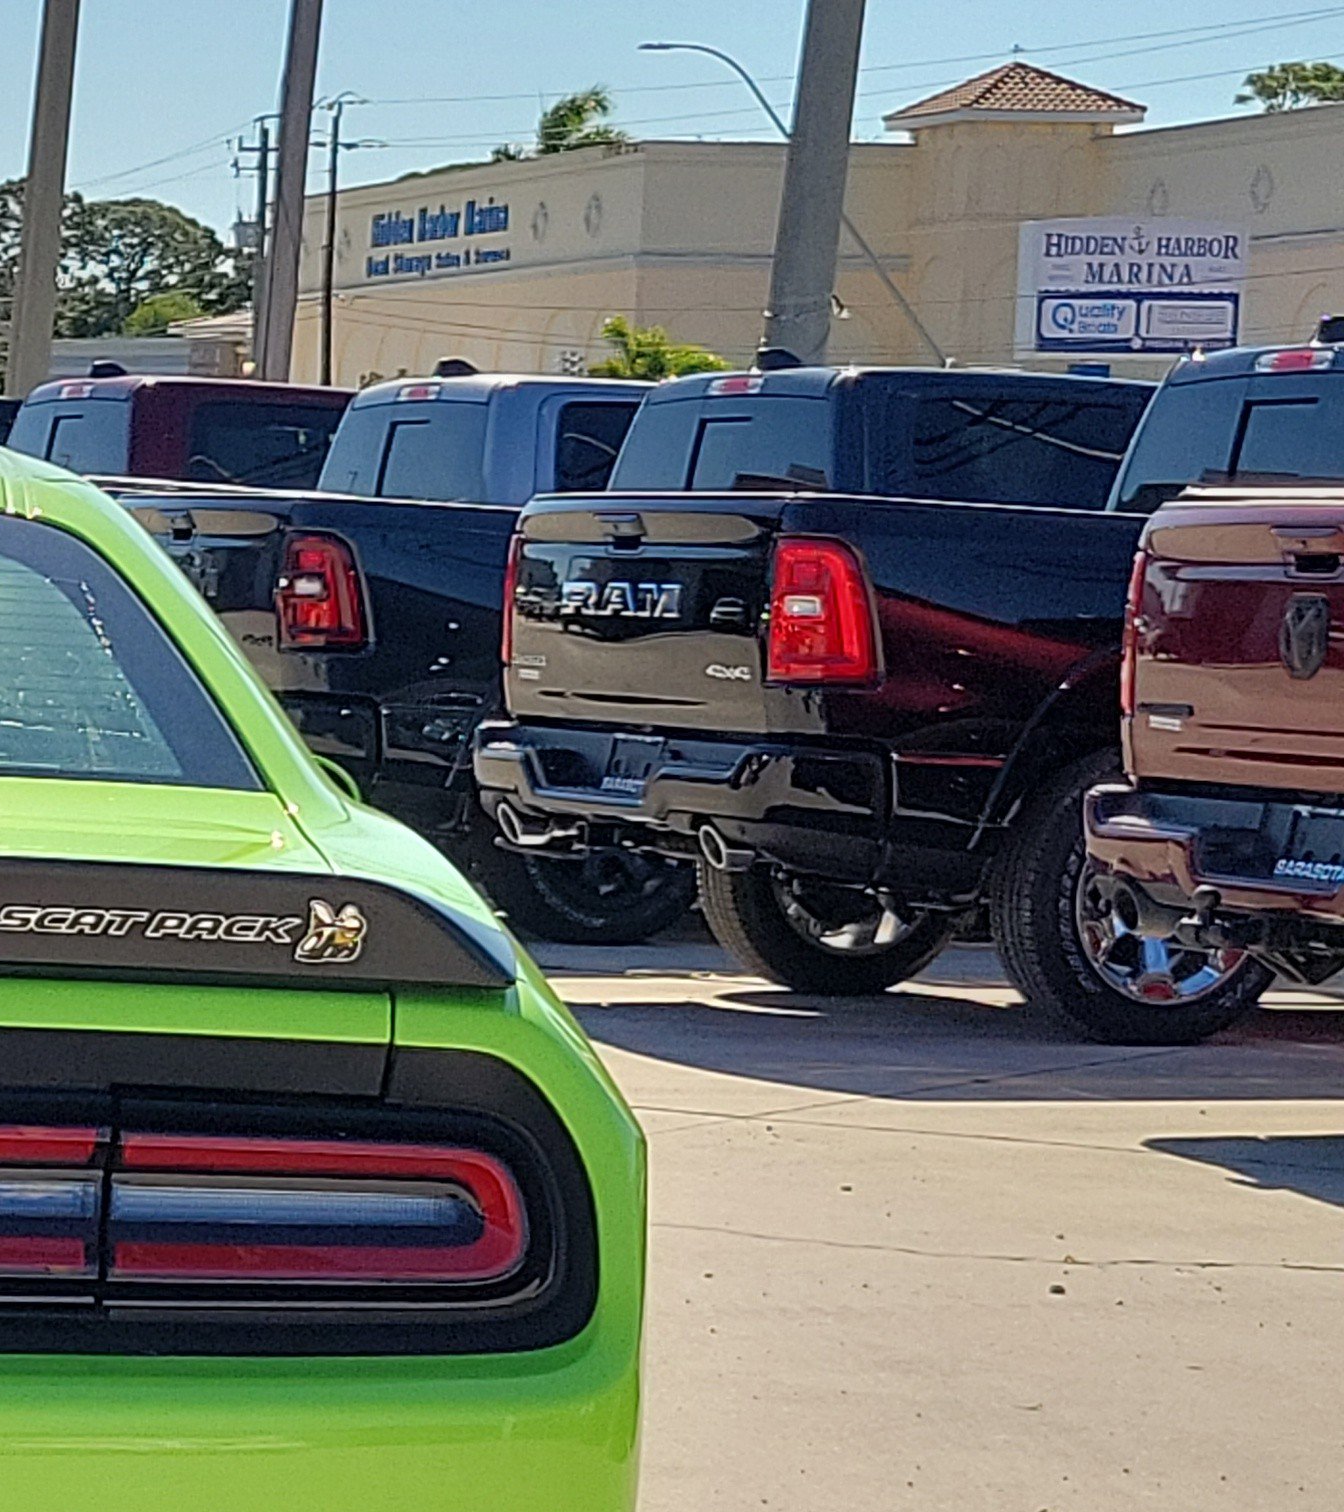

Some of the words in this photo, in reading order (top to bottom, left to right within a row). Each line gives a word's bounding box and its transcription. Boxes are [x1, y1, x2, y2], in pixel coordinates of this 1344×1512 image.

[1044, 233, 1127, 258] HIDDEN
[1155, 235, 1239, 260] HARBOR
[1084, 262, 1193, 285] MARINA
[561, 581, 682, 617] RAM
[143, 911, 303, 945] PACK
